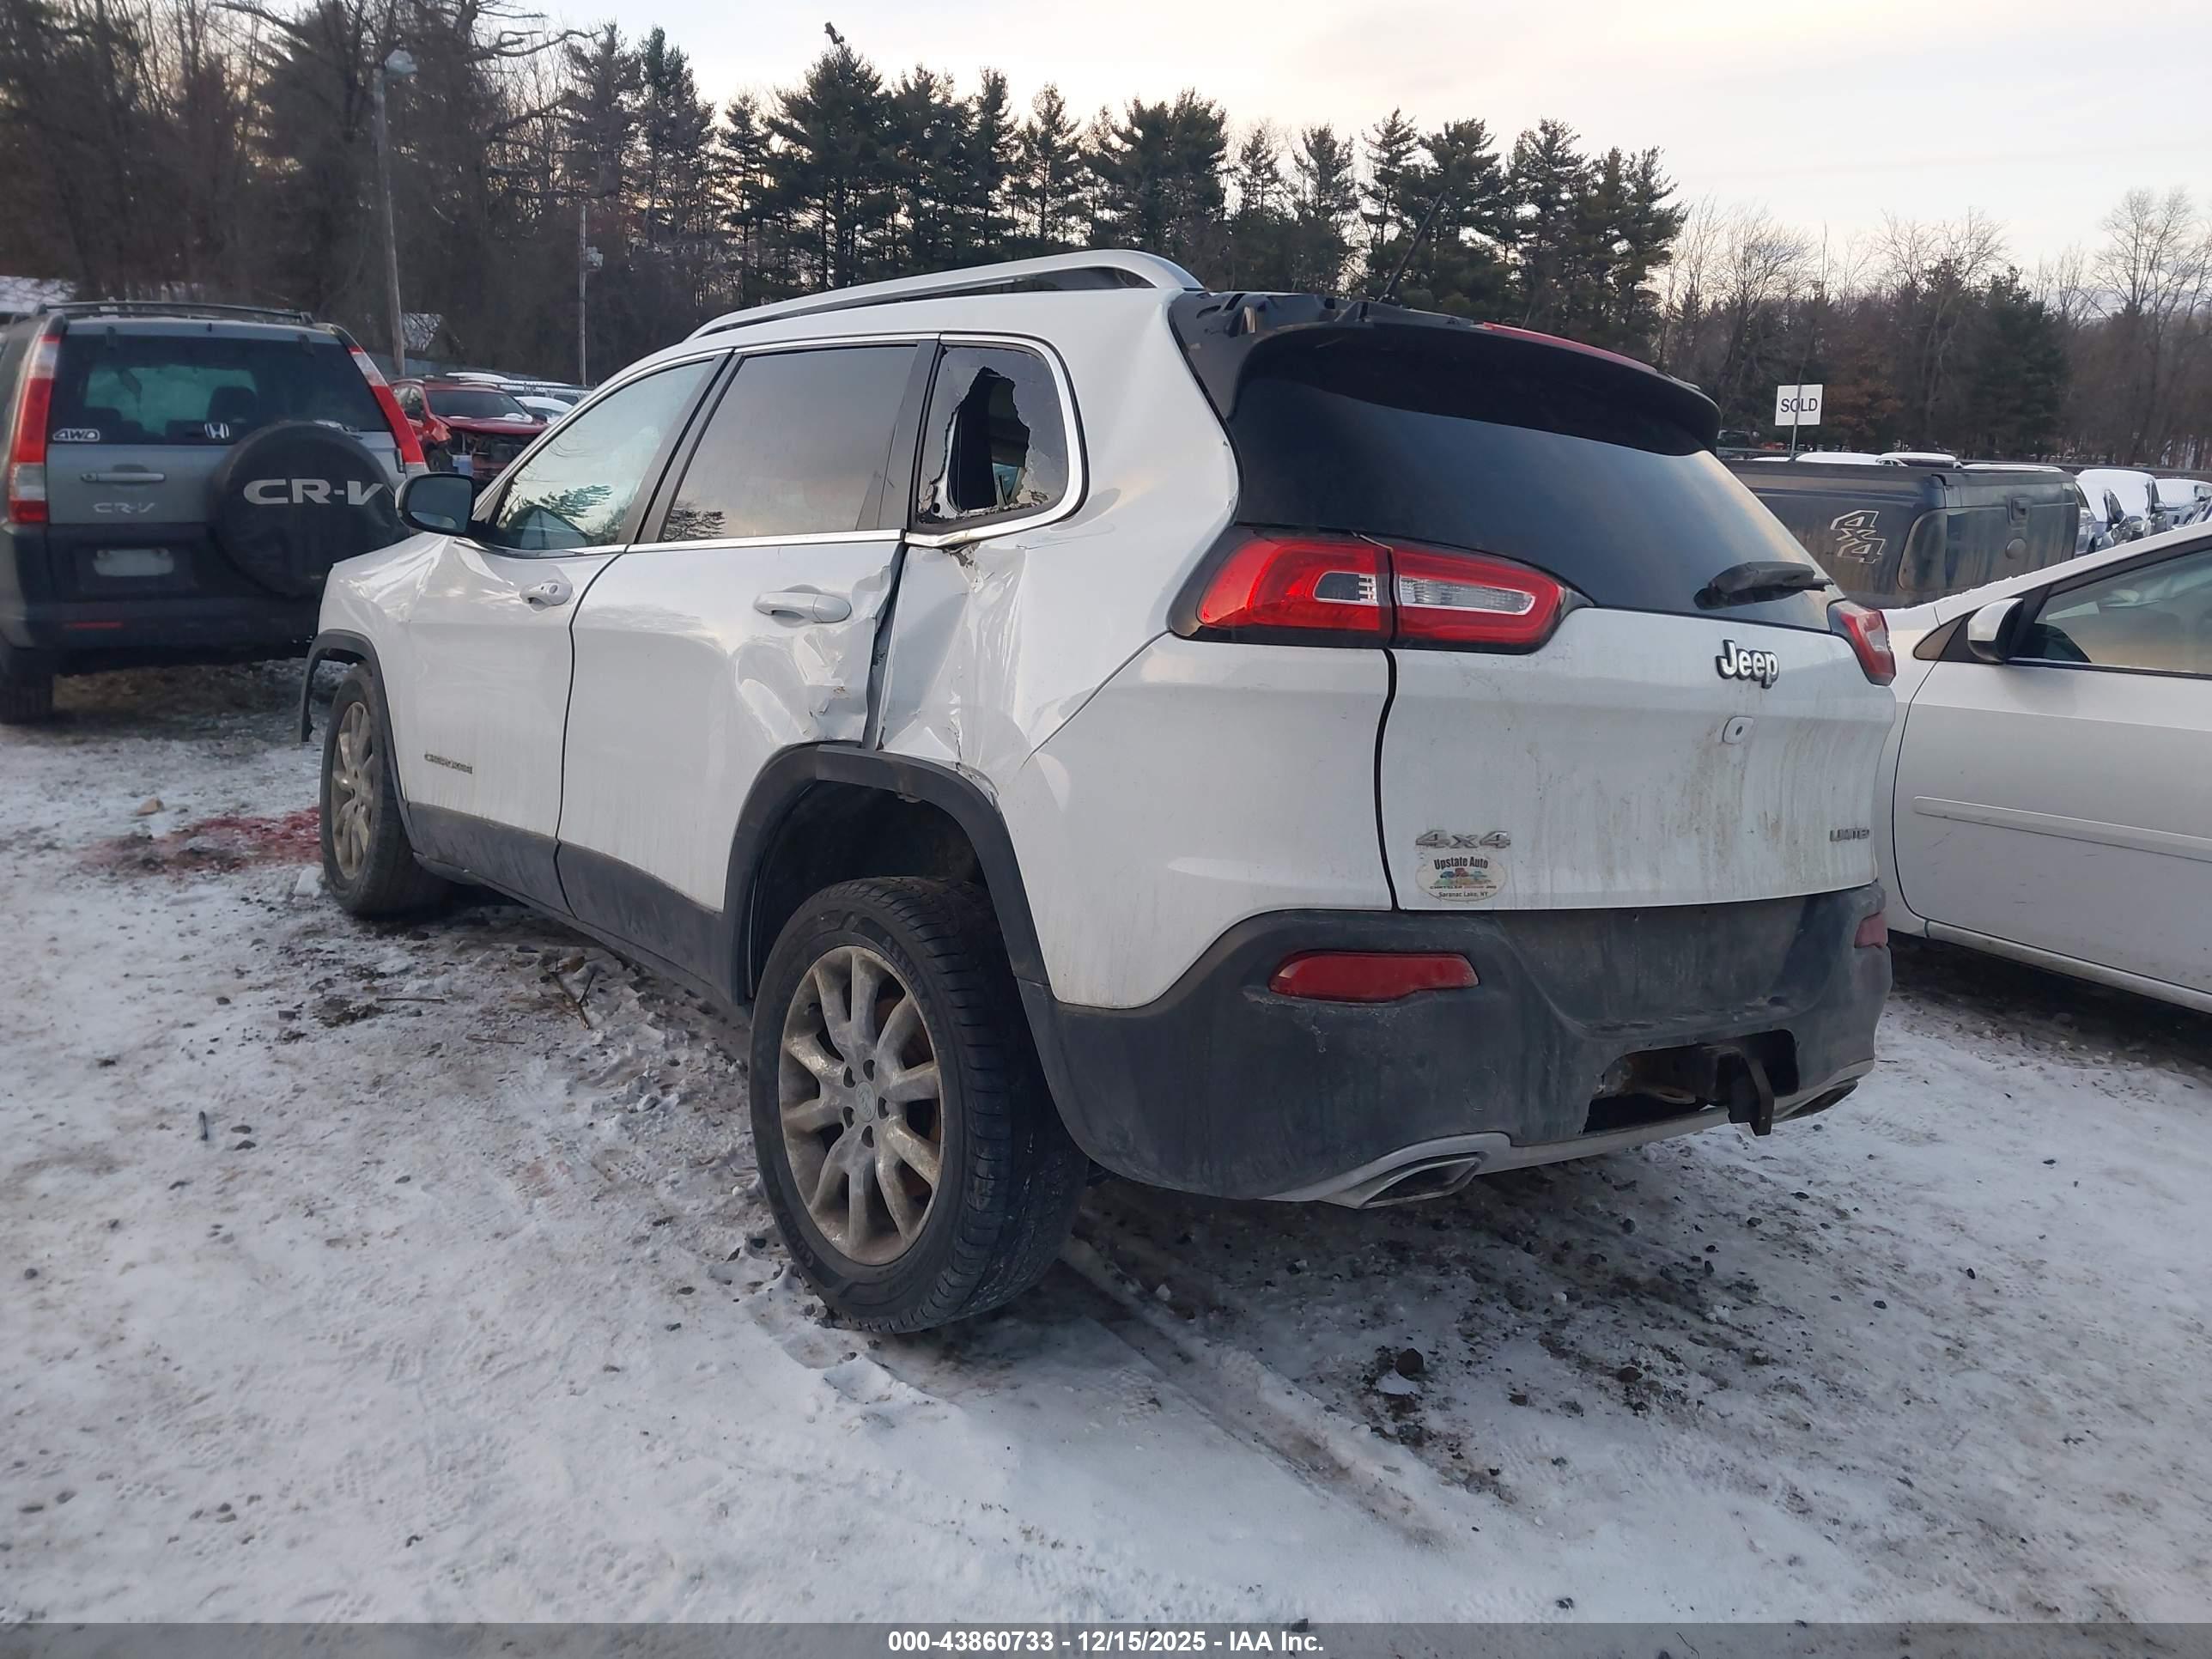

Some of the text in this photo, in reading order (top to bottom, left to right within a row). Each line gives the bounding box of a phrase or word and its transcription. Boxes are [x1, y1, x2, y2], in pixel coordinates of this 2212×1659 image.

[1780, 398, 1818, 413] SOLD
[53, 428, 100, 441] AWD
[243, 478, 384, 506] CR-V
[93, 502, 155, 514] CR-V
[1716, 639, 1780, 690] Jeep
[1434, 855, 1489, 871] Upstate Auto
